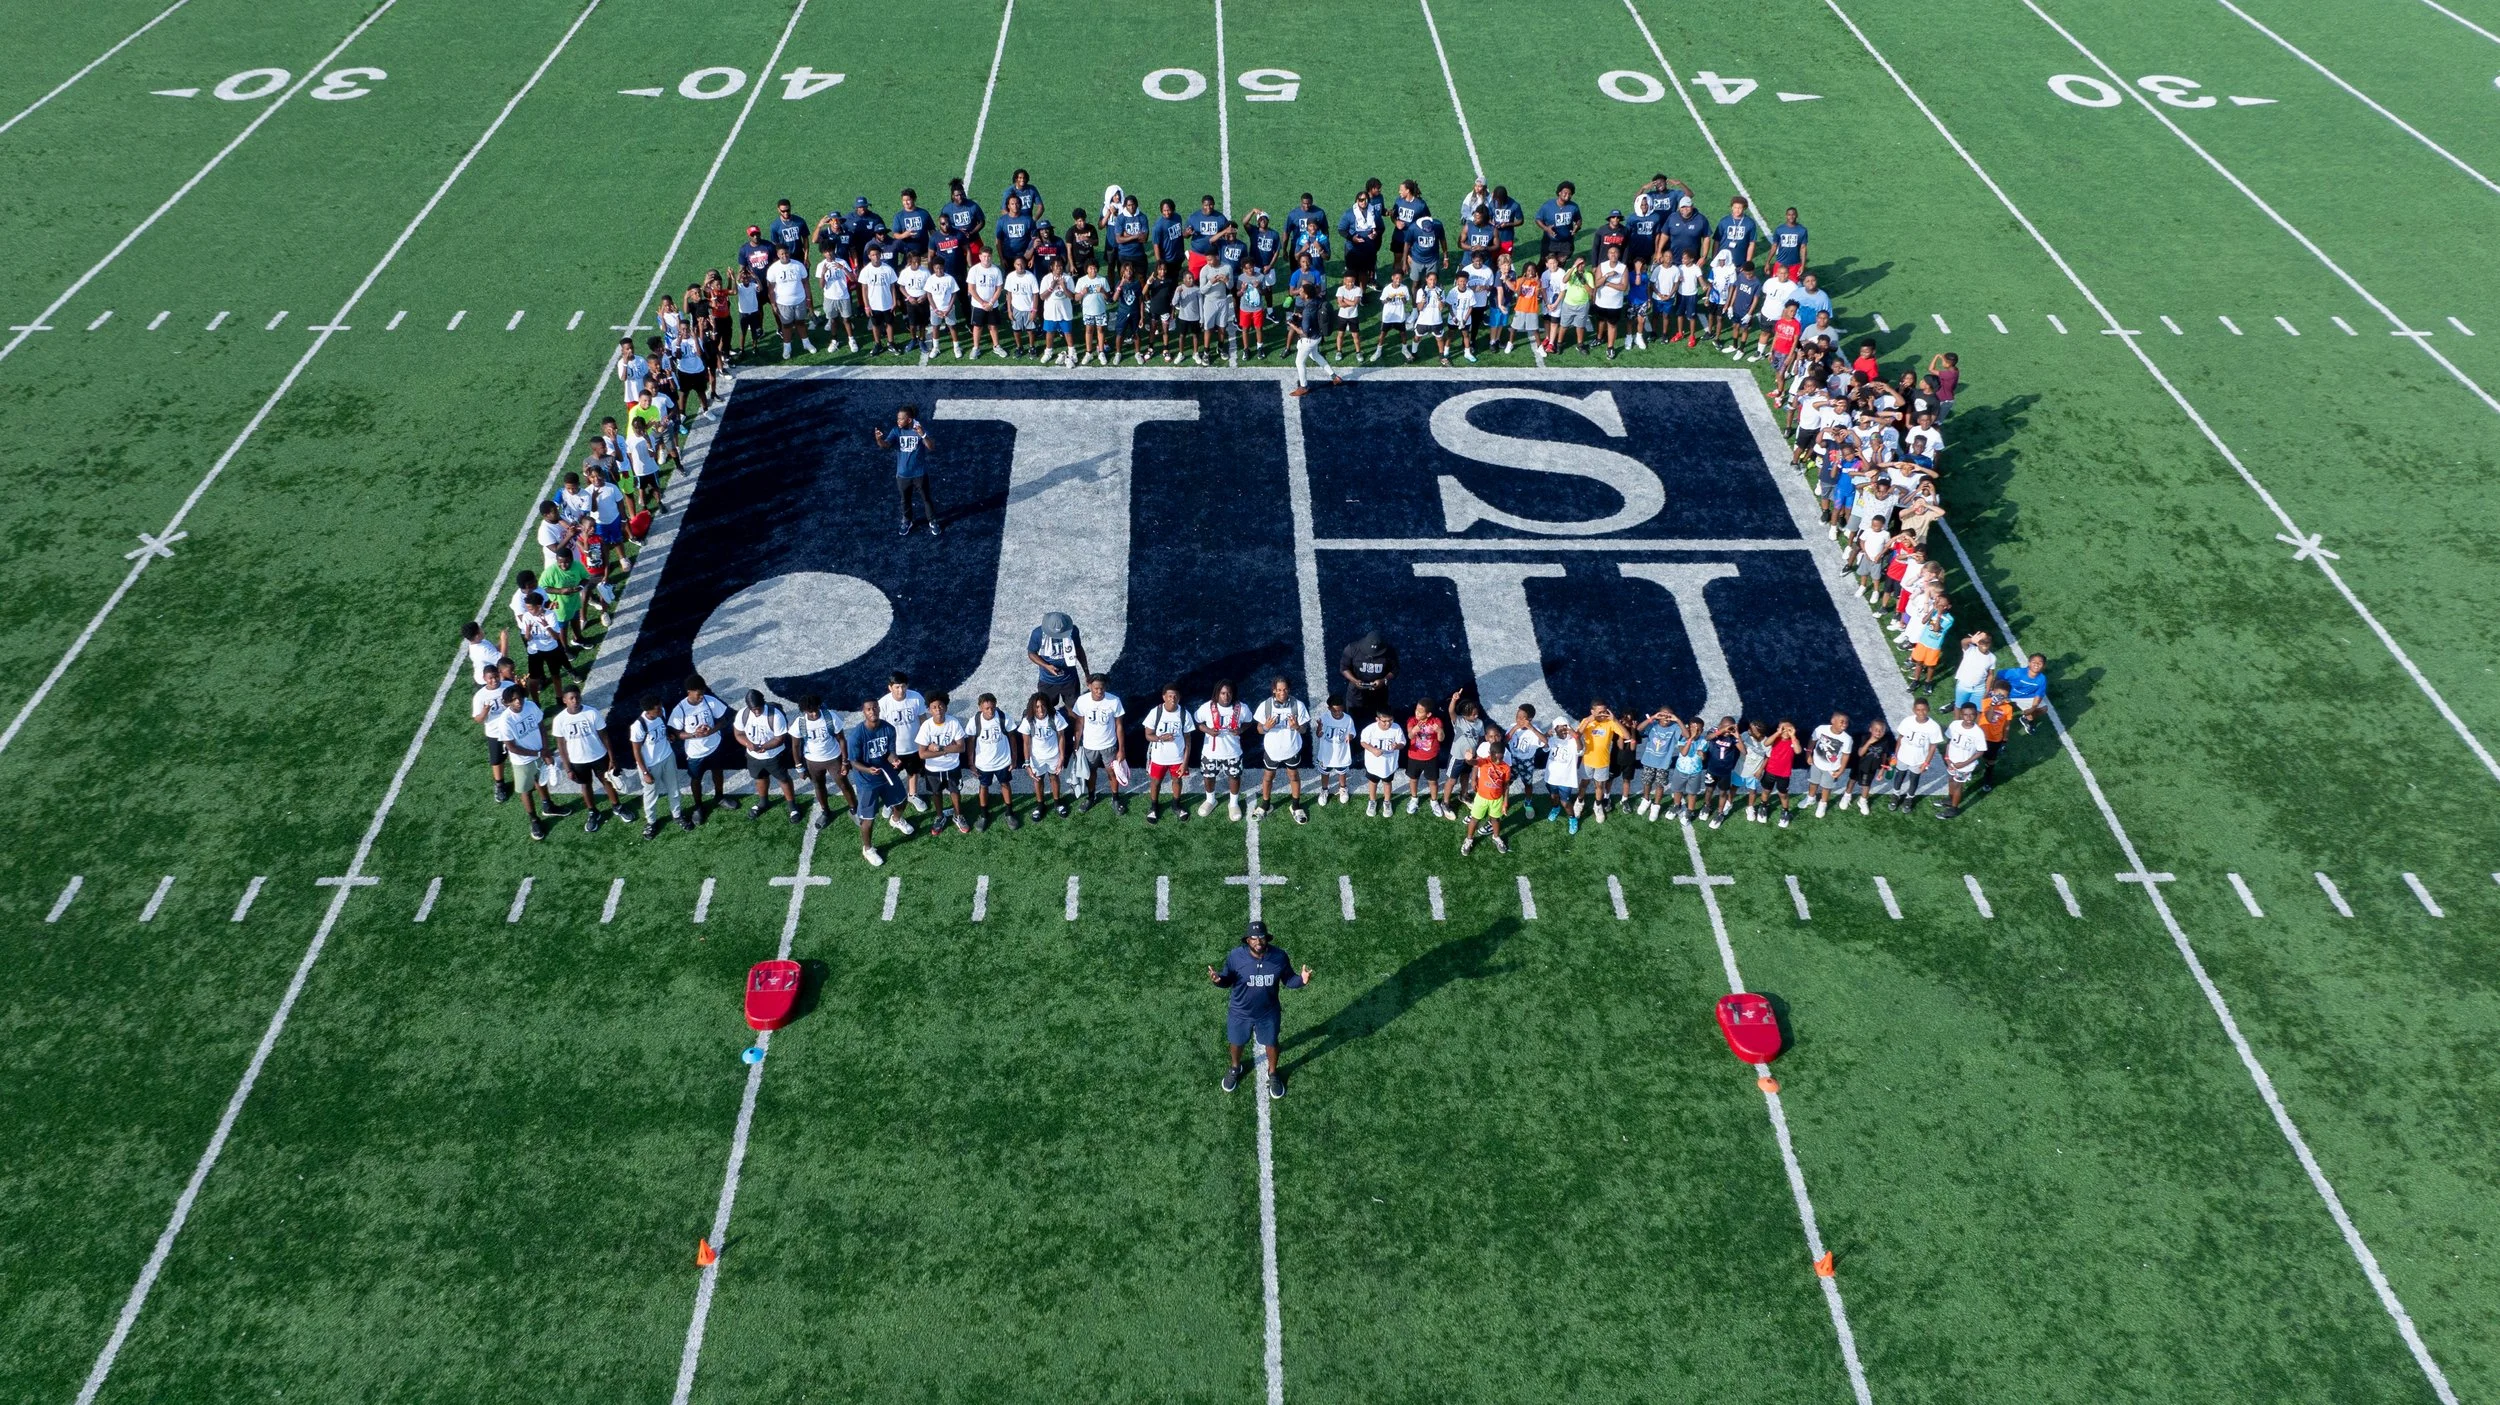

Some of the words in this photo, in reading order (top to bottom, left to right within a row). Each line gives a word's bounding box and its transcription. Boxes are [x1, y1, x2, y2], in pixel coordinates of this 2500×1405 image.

[1740, 283, 1751, 294] USA
[1360, 662, 1383, 673] JSU
[1247, 973, 1275, 987] JSU
